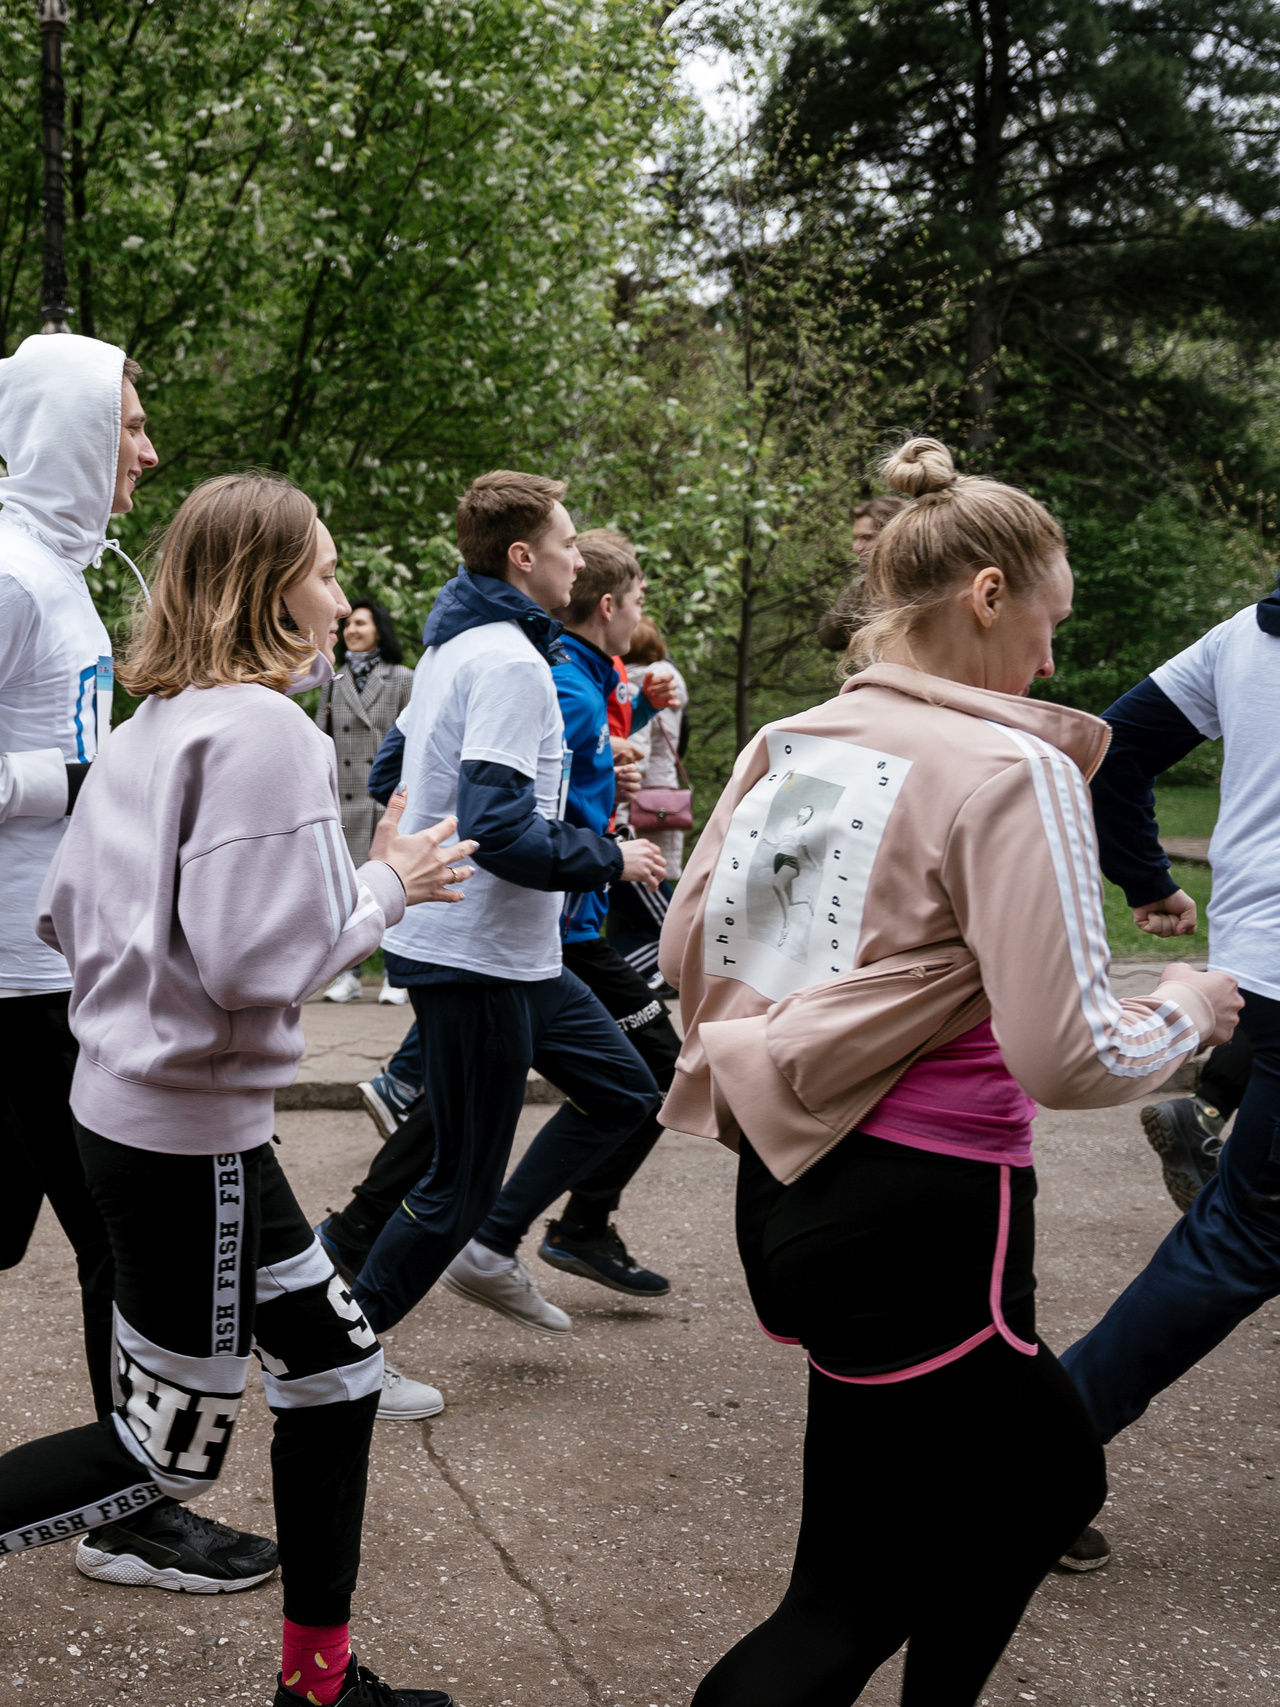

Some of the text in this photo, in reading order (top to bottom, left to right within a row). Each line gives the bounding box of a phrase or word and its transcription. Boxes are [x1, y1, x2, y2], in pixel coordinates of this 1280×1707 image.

[216, 1153, 241, 1355] RSH FRSH FRS
[17, 1512, 90, 1547] FRSH
